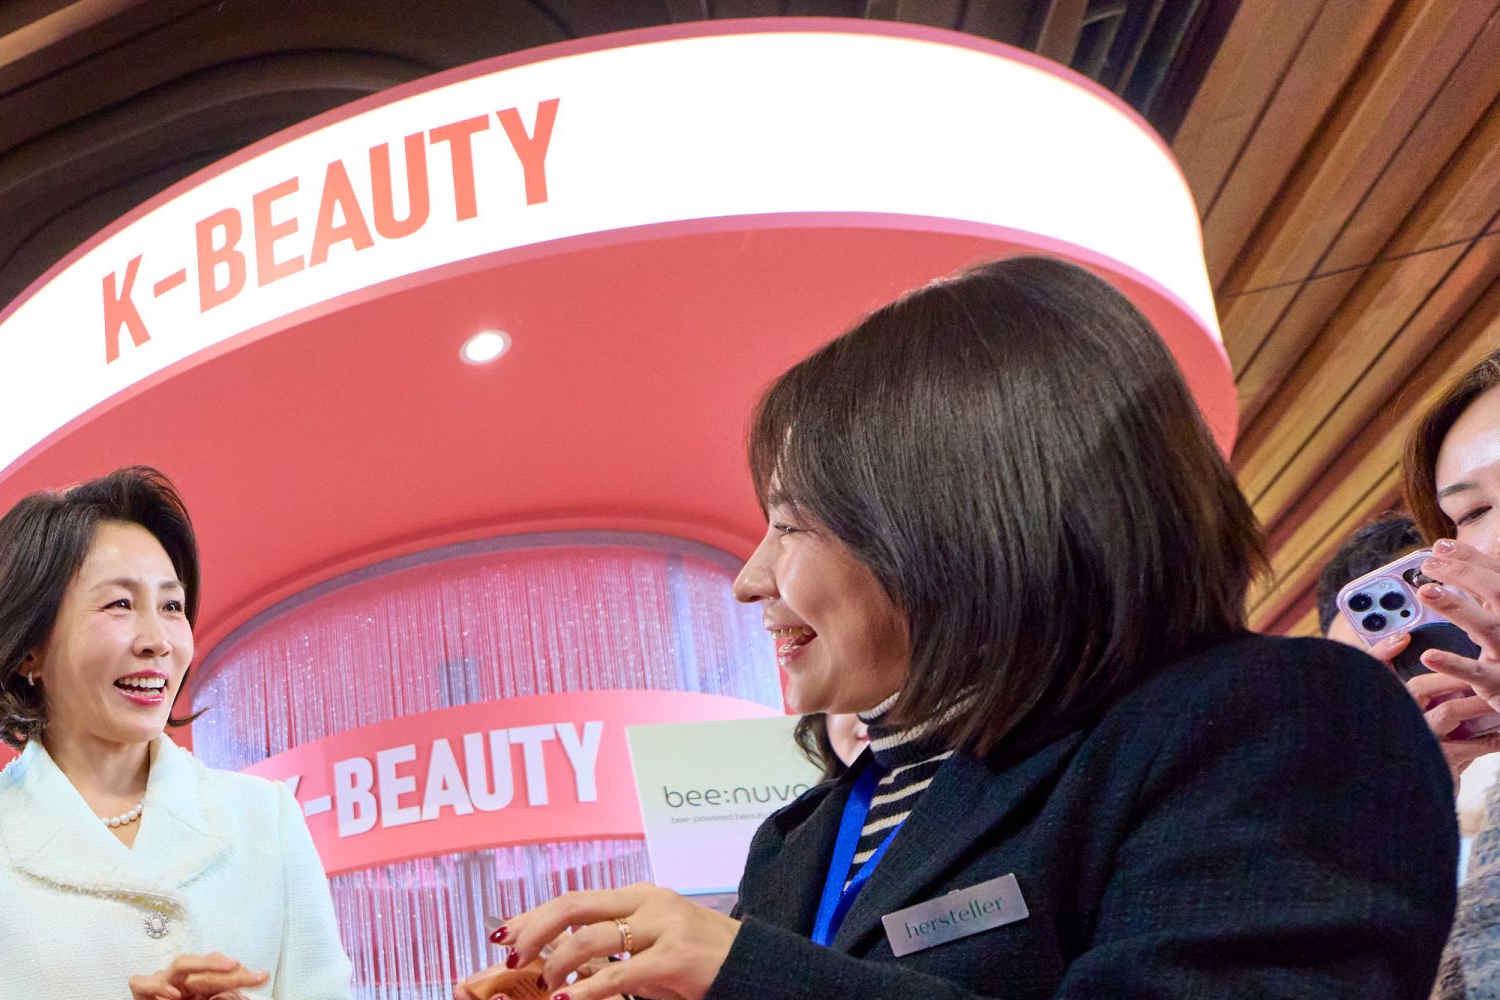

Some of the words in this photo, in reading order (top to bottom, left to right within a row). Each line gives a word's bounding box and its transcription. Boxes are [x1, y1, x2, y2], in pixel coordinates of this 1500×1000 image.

[102, 97, 561, 365] K-BEAUTY
[284, 720, 604, 839] -BEAUTY
[904, 897, 1003, 939] hersteller
